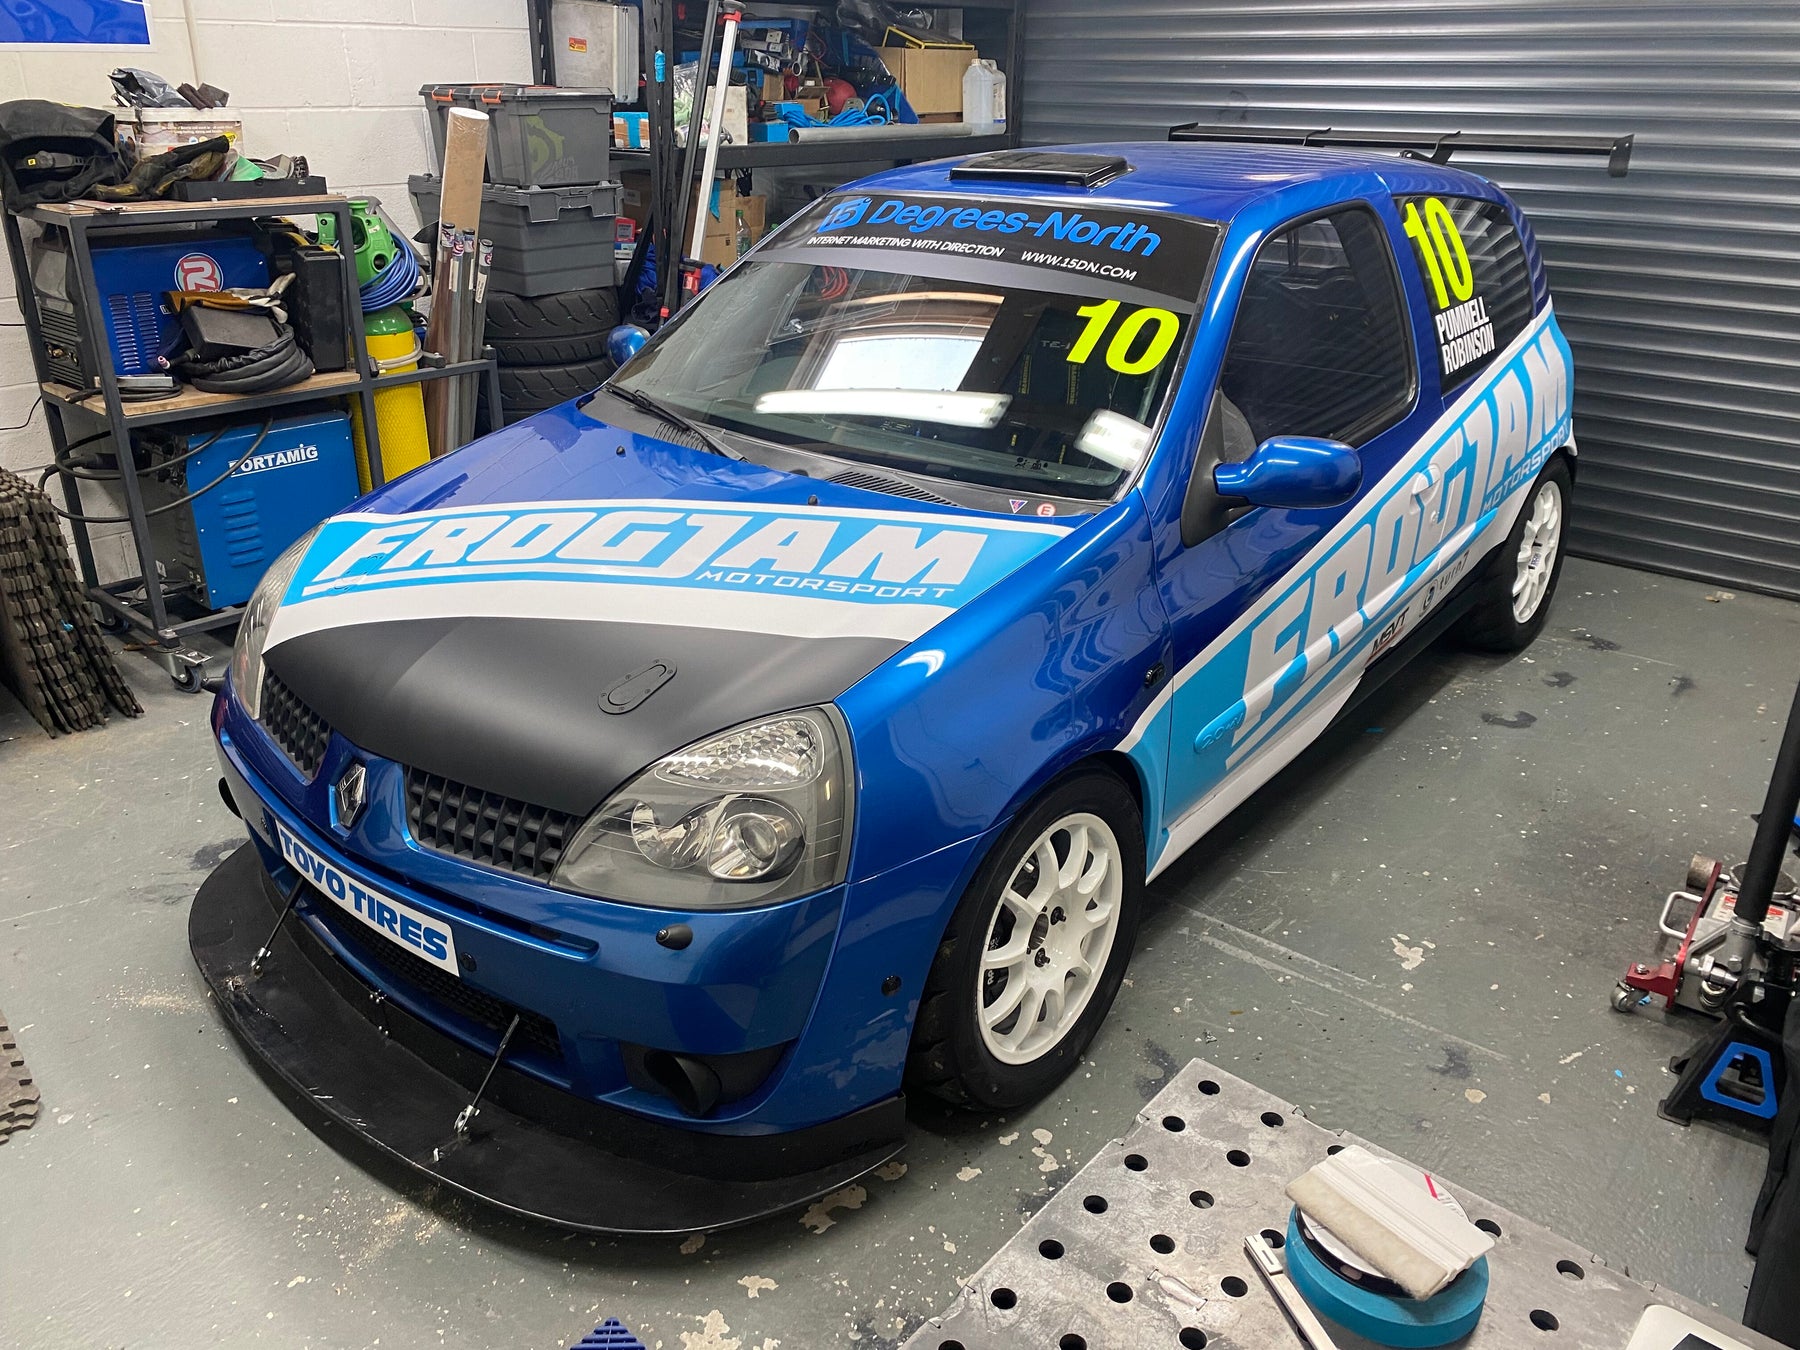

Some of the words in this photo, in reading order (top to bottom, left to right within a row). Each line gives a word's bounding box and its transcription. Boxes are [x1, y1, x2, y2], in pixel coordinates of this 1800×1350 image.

[807, 235, 853, 246] INTERNET
[851, 236, 912, 248] MARKETING
[911, 238, 941, 250] WITH
[939, 241, 1005, 257] DIRECTION
[866, 201, 1161, 257] Degrees-North
[1403, 197, 1474, 309] 10
[1021, 250, 1138, 281] WWW.15DN.COM
[1066, 299, 1180, 375] 10
[1434, 296, 1490, 344] PUMMELL
[1441, 322, 1496, 375] ROBINSON
[1481, 418, 1569, 516] MOTORSPORT
[1040, 505, 1052, 516] E
[1231, 325, 1567, 748] FROGJAM
[308, 511, 988, 585] FROGJAM
[695, 570, 955, 598] MOTORSPORT
[1372, 606, 1410, 653] MSVT
[280, 827, 346, 901] TOYO
[349, 882, 448, 961] TIRES
